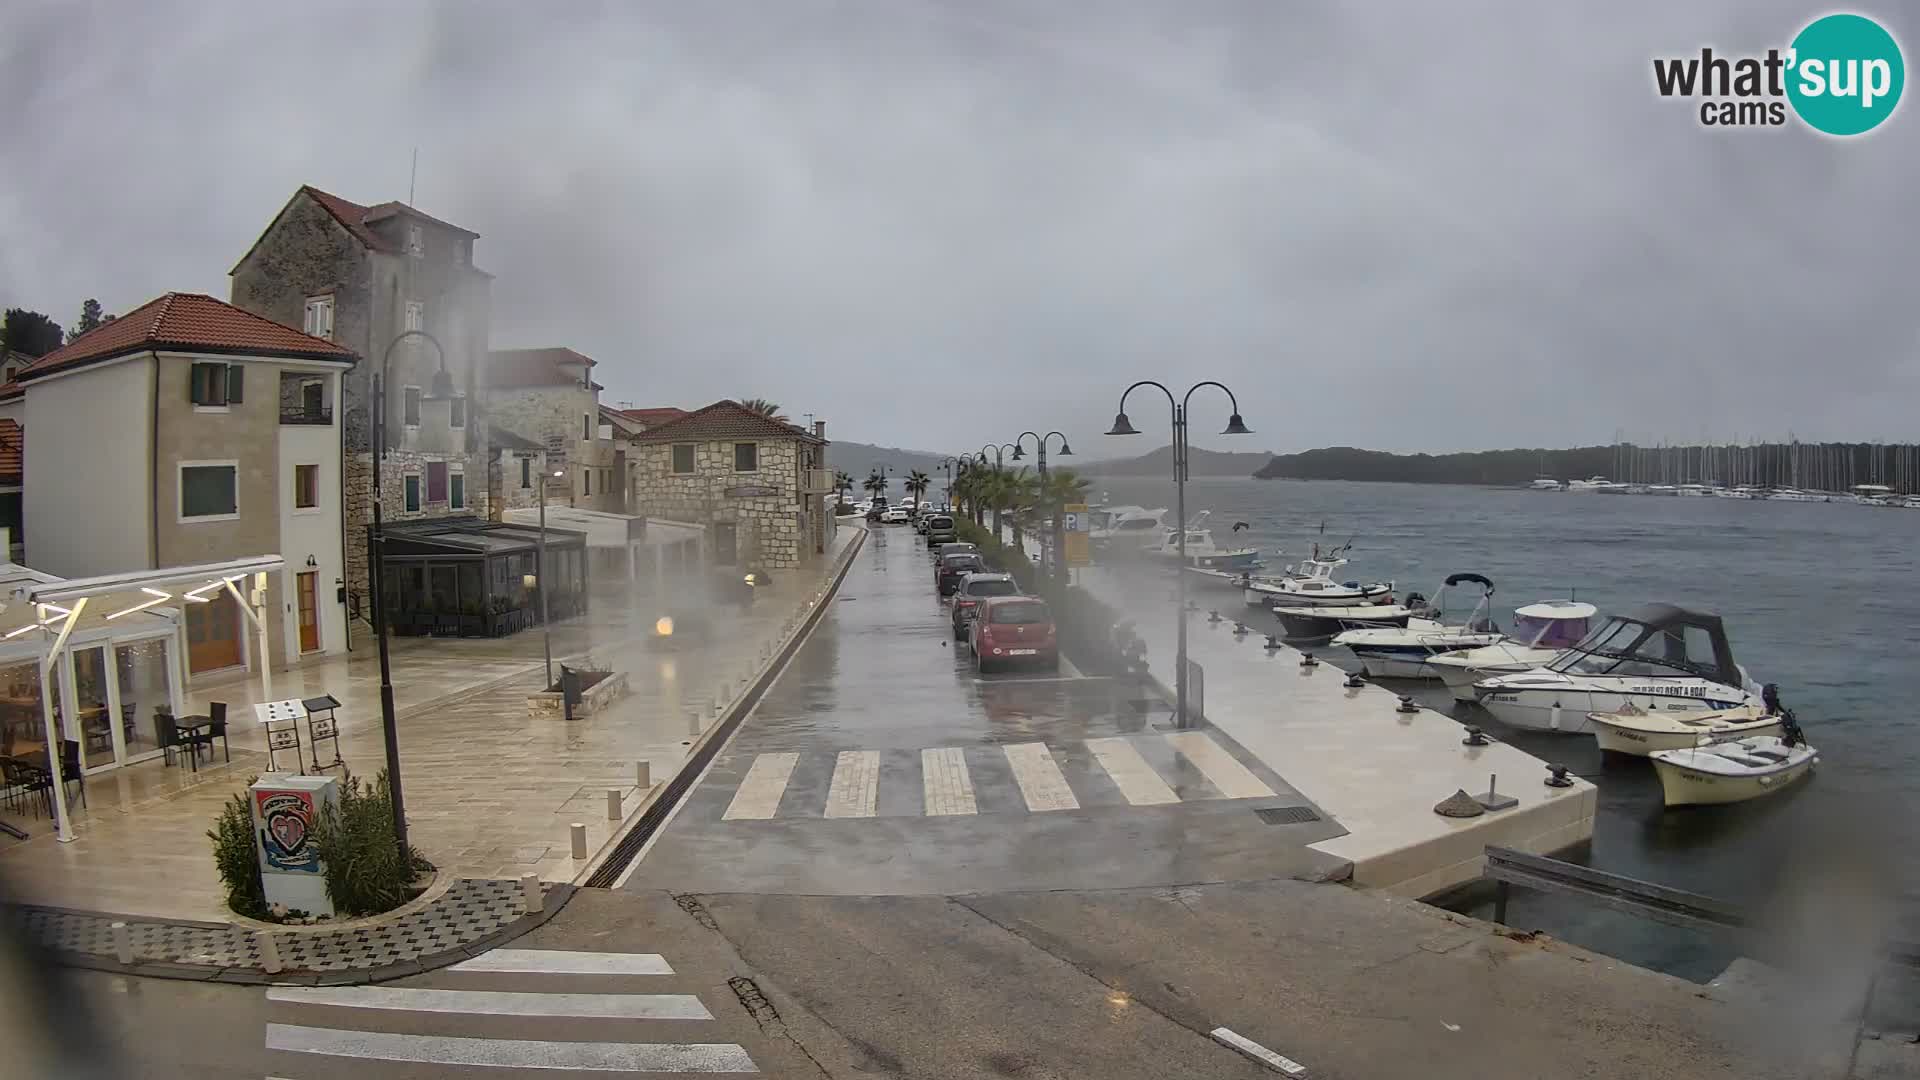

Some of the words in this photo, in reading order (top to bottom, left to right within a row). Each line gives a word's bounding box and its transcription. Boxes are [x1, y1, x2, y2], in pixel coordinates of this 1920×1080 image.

[1665, 686, 1683, 696] RENT
[1684, 687, 1689, 697] A
[1690, 687, 1707, 697] BOAT
